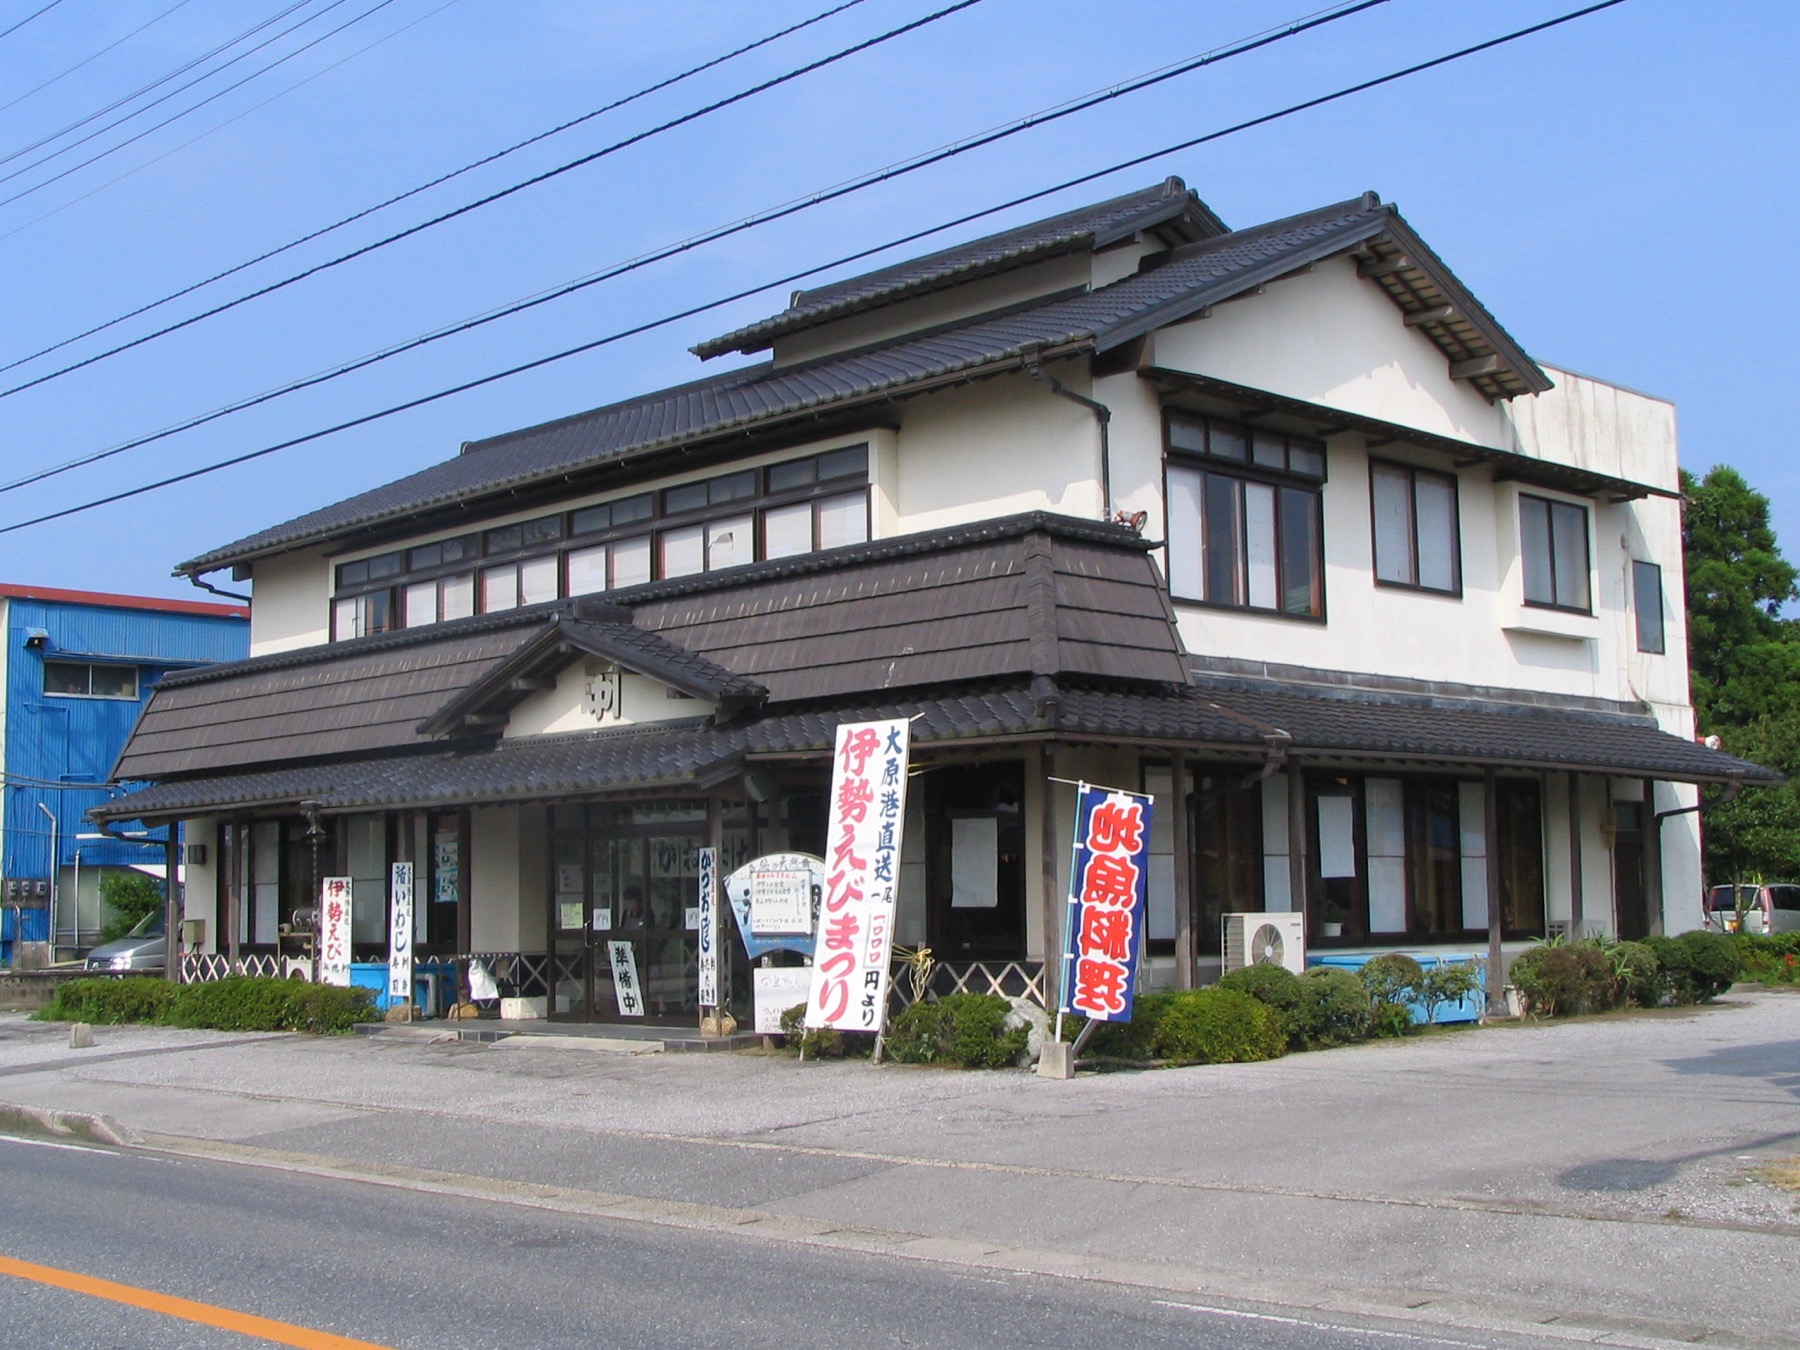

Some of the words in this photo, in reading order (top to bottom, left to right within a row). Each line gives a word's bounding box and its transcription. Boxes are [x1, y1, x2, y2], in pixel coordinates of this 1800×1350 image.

[874, 725, 903, 882] 大原港直送
[818, 728, 881, 1022] 伊勢えびまつり
[871, 886, 893, 903] 一尾
[327, 880, 345, 960] 伊勢えび
[615, 944, 636, 1014] 準備中
